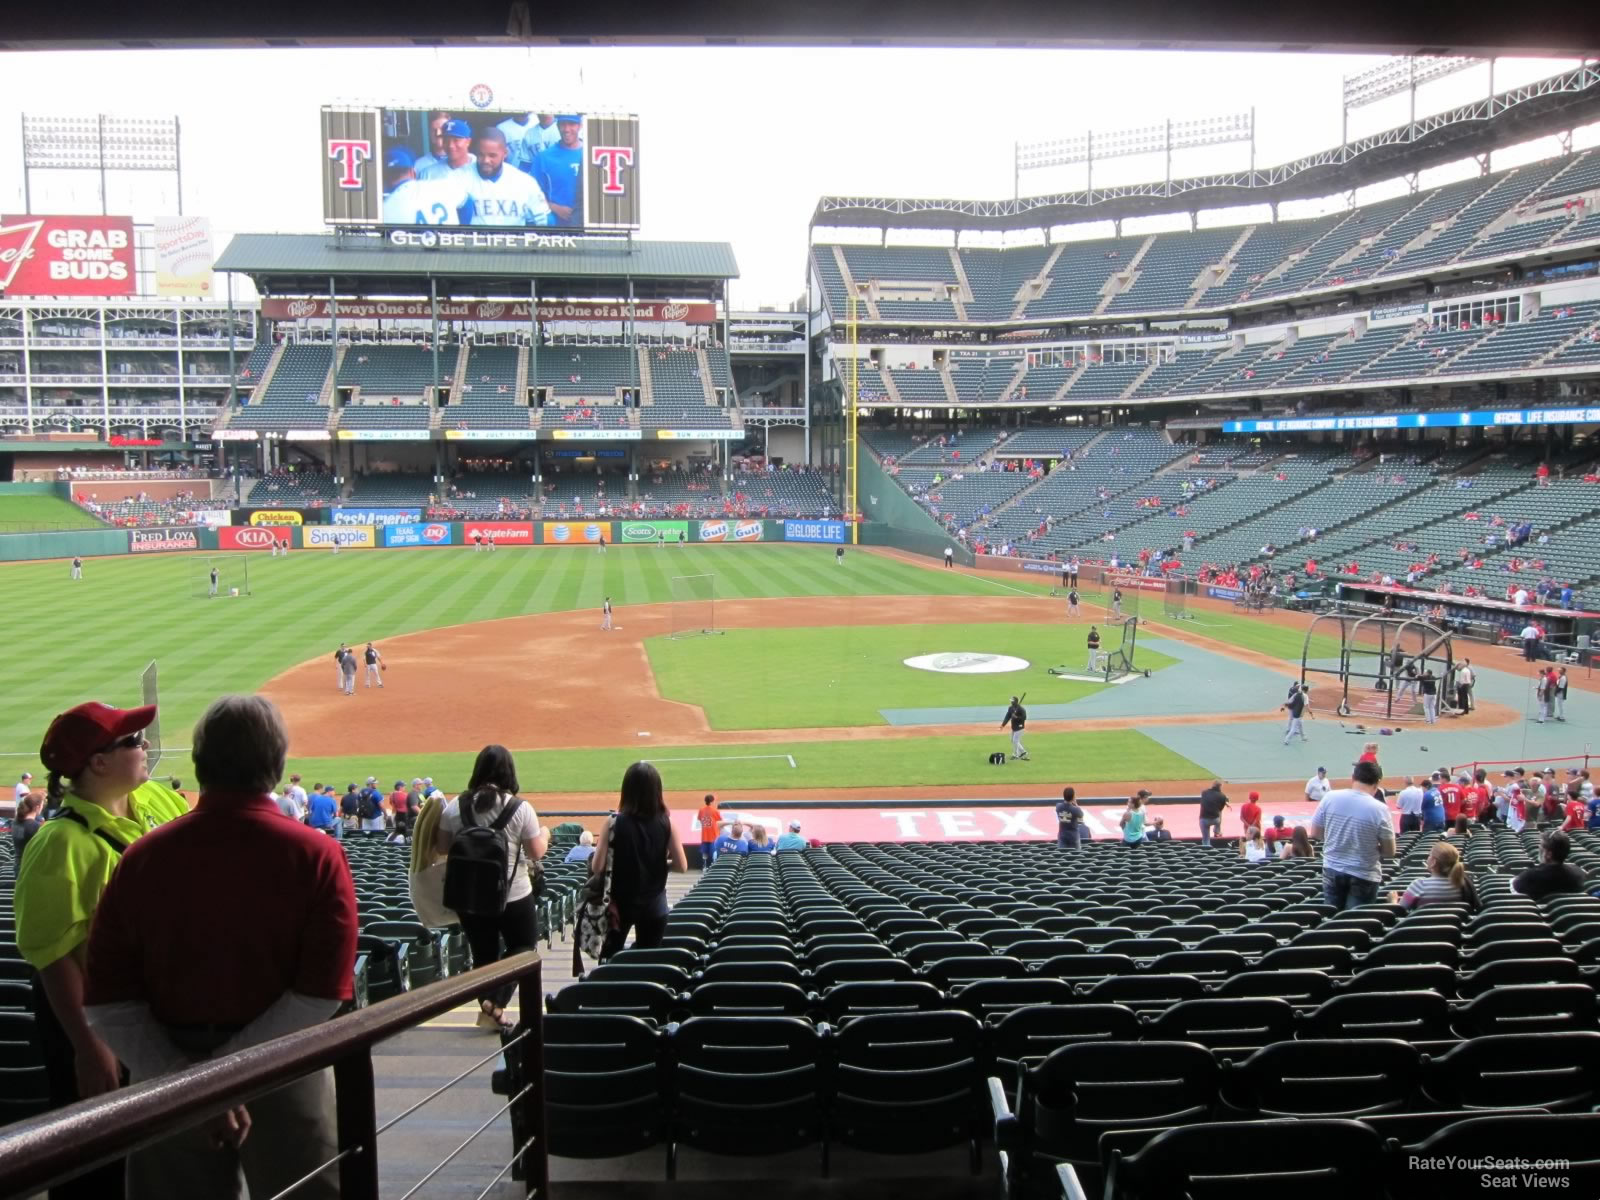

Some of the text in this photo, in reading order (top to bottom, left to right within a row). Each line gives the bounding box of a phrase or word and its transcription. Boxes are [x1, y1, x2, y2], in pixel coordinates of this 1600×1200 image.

[328, 139, 371, 189] T
[592, 146, 634, 194] T
[48, 230, 128, 248] GRAB
[391, 230, 577, 248] GLOBE LIFE PARK
[63, 249, 114, 261] SOME
[50, 261, 128, 280] BUDS
[322, 302, 375, 317] Always
[377, 303, 404, 315] One
[408, 303, 422, 315] of
[511, 303, 563, 318] Always
[564, 304, 592, 316] One
[594, 304, 609, 317] of
[1527, 411, 1543, 422] LIFE
[258, 513, 295, 521] Chicken
[132, 529, 196, 542] FRED LOYA
[242, 532, 268, 543] KIA
[311, 529, 367, 545] Snapple
[427, 528, 443, 537] DQ
[628, 527, 652, 535] Scotts
[702, 525, 729, 539] Gulf
[736, 525, 761, 539] Gulf
[795, 523, 841, 539] GLOBE LIFE
[132, 540, 197, 551] INSURANCE
